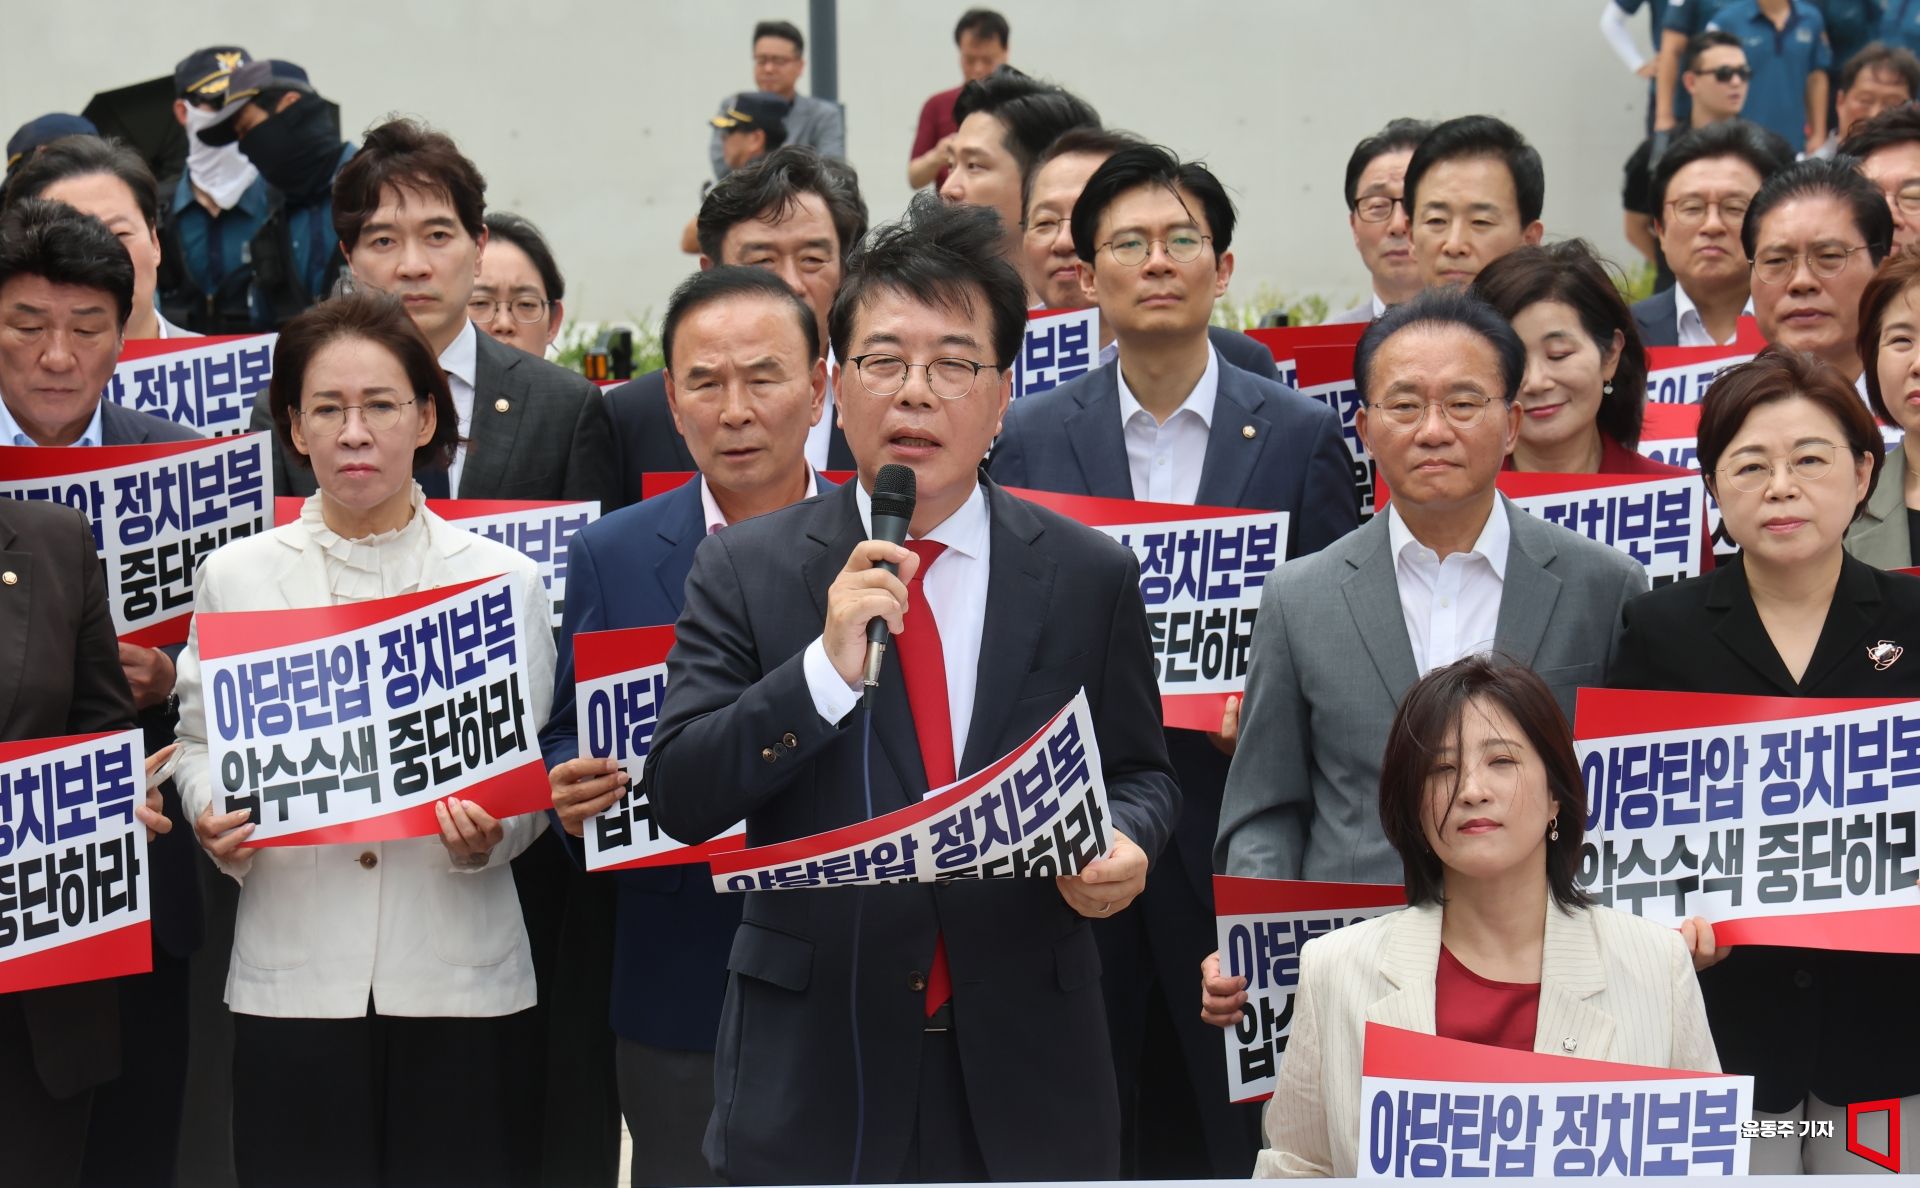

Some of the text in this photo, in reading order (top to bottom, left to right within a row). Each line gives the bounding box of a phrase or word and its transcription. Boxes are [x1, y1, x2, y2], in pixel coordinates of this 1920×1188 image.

[1010, 319, 1090, 399] 보복
[114, 443, 263, 546] 정치보복
[1140, 523, 1278, 605] 정치보복
[213, 584, 518, 742] 야당탄압 정치보복
[221, 672, 528, 826] 압수수색 중단하라
[1581, 734, 1749, 832] 야당탄압
[727, 711, 1091, 891] 야당탄압 정치보복
[1370, 1088, 1738, 1178] 야당탄압 정치보복
